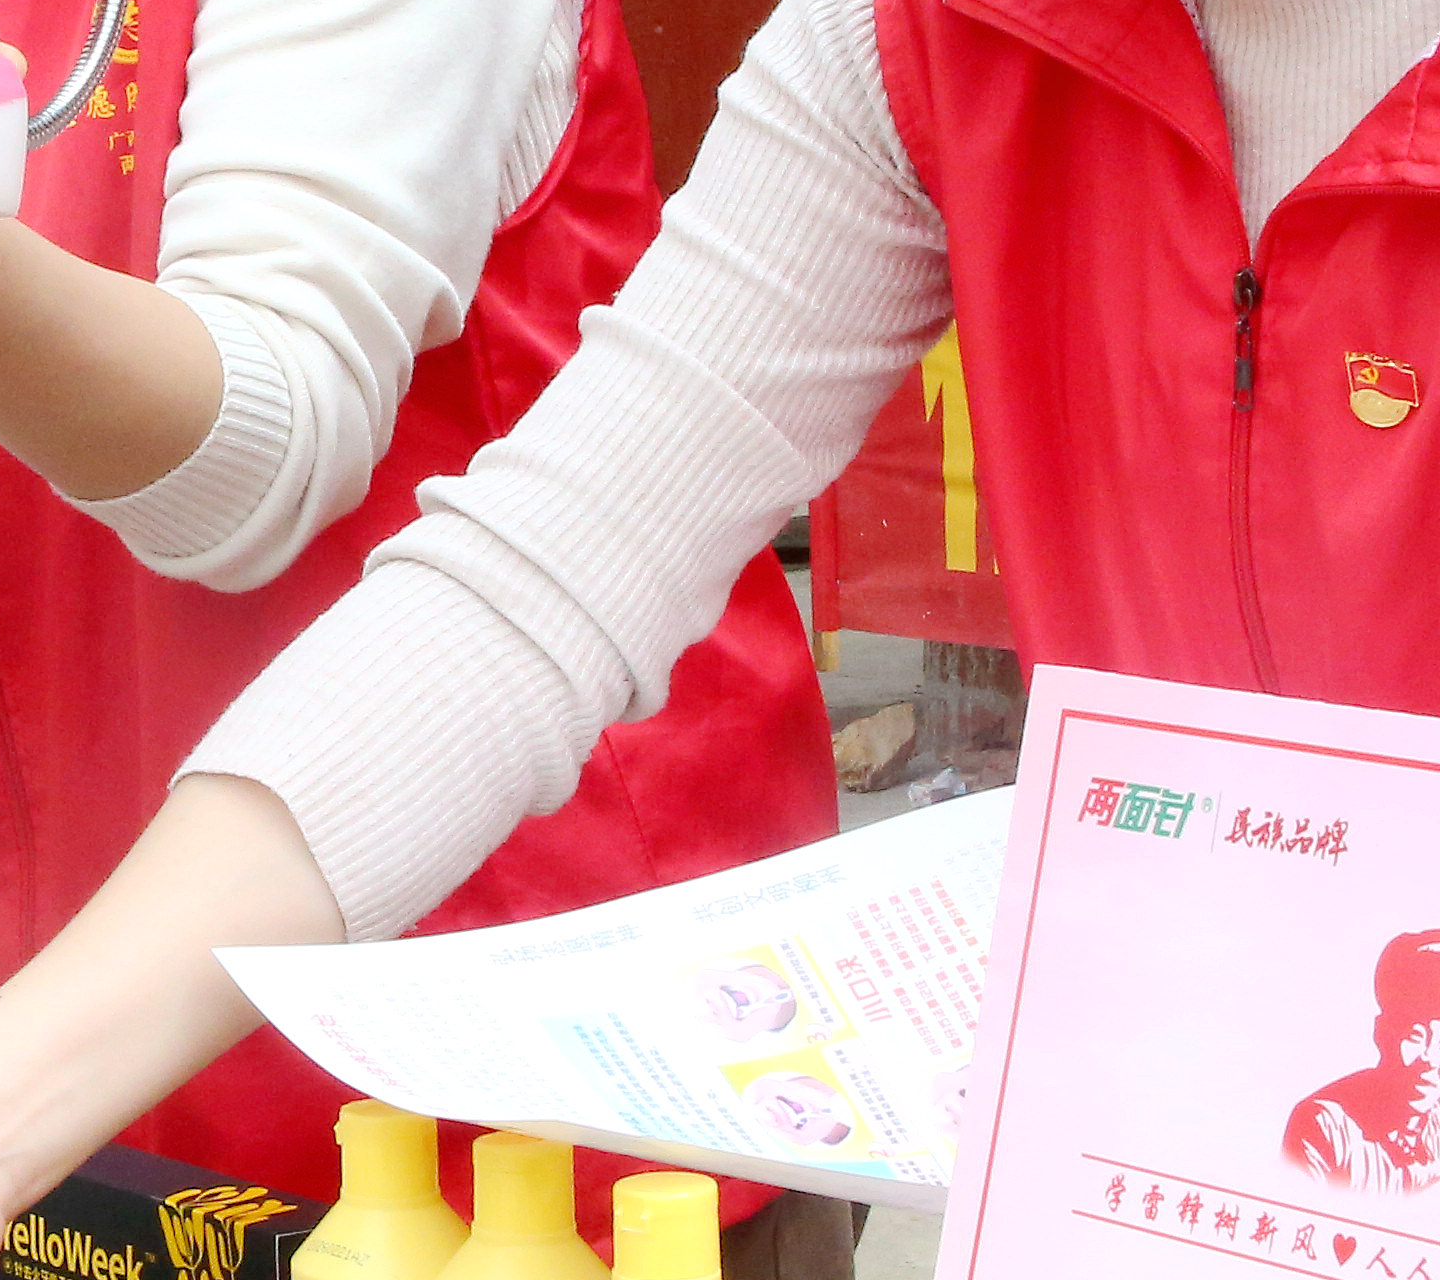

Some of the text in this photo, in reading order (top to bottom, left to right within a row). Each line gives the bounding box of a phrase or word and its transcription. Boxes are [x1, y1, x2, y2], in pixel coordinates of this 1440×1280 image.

[1078, 777, 1349, 866] 两面针 民族品牌
[1103, 1173, 1318, 1261] 学雷锋树新风
